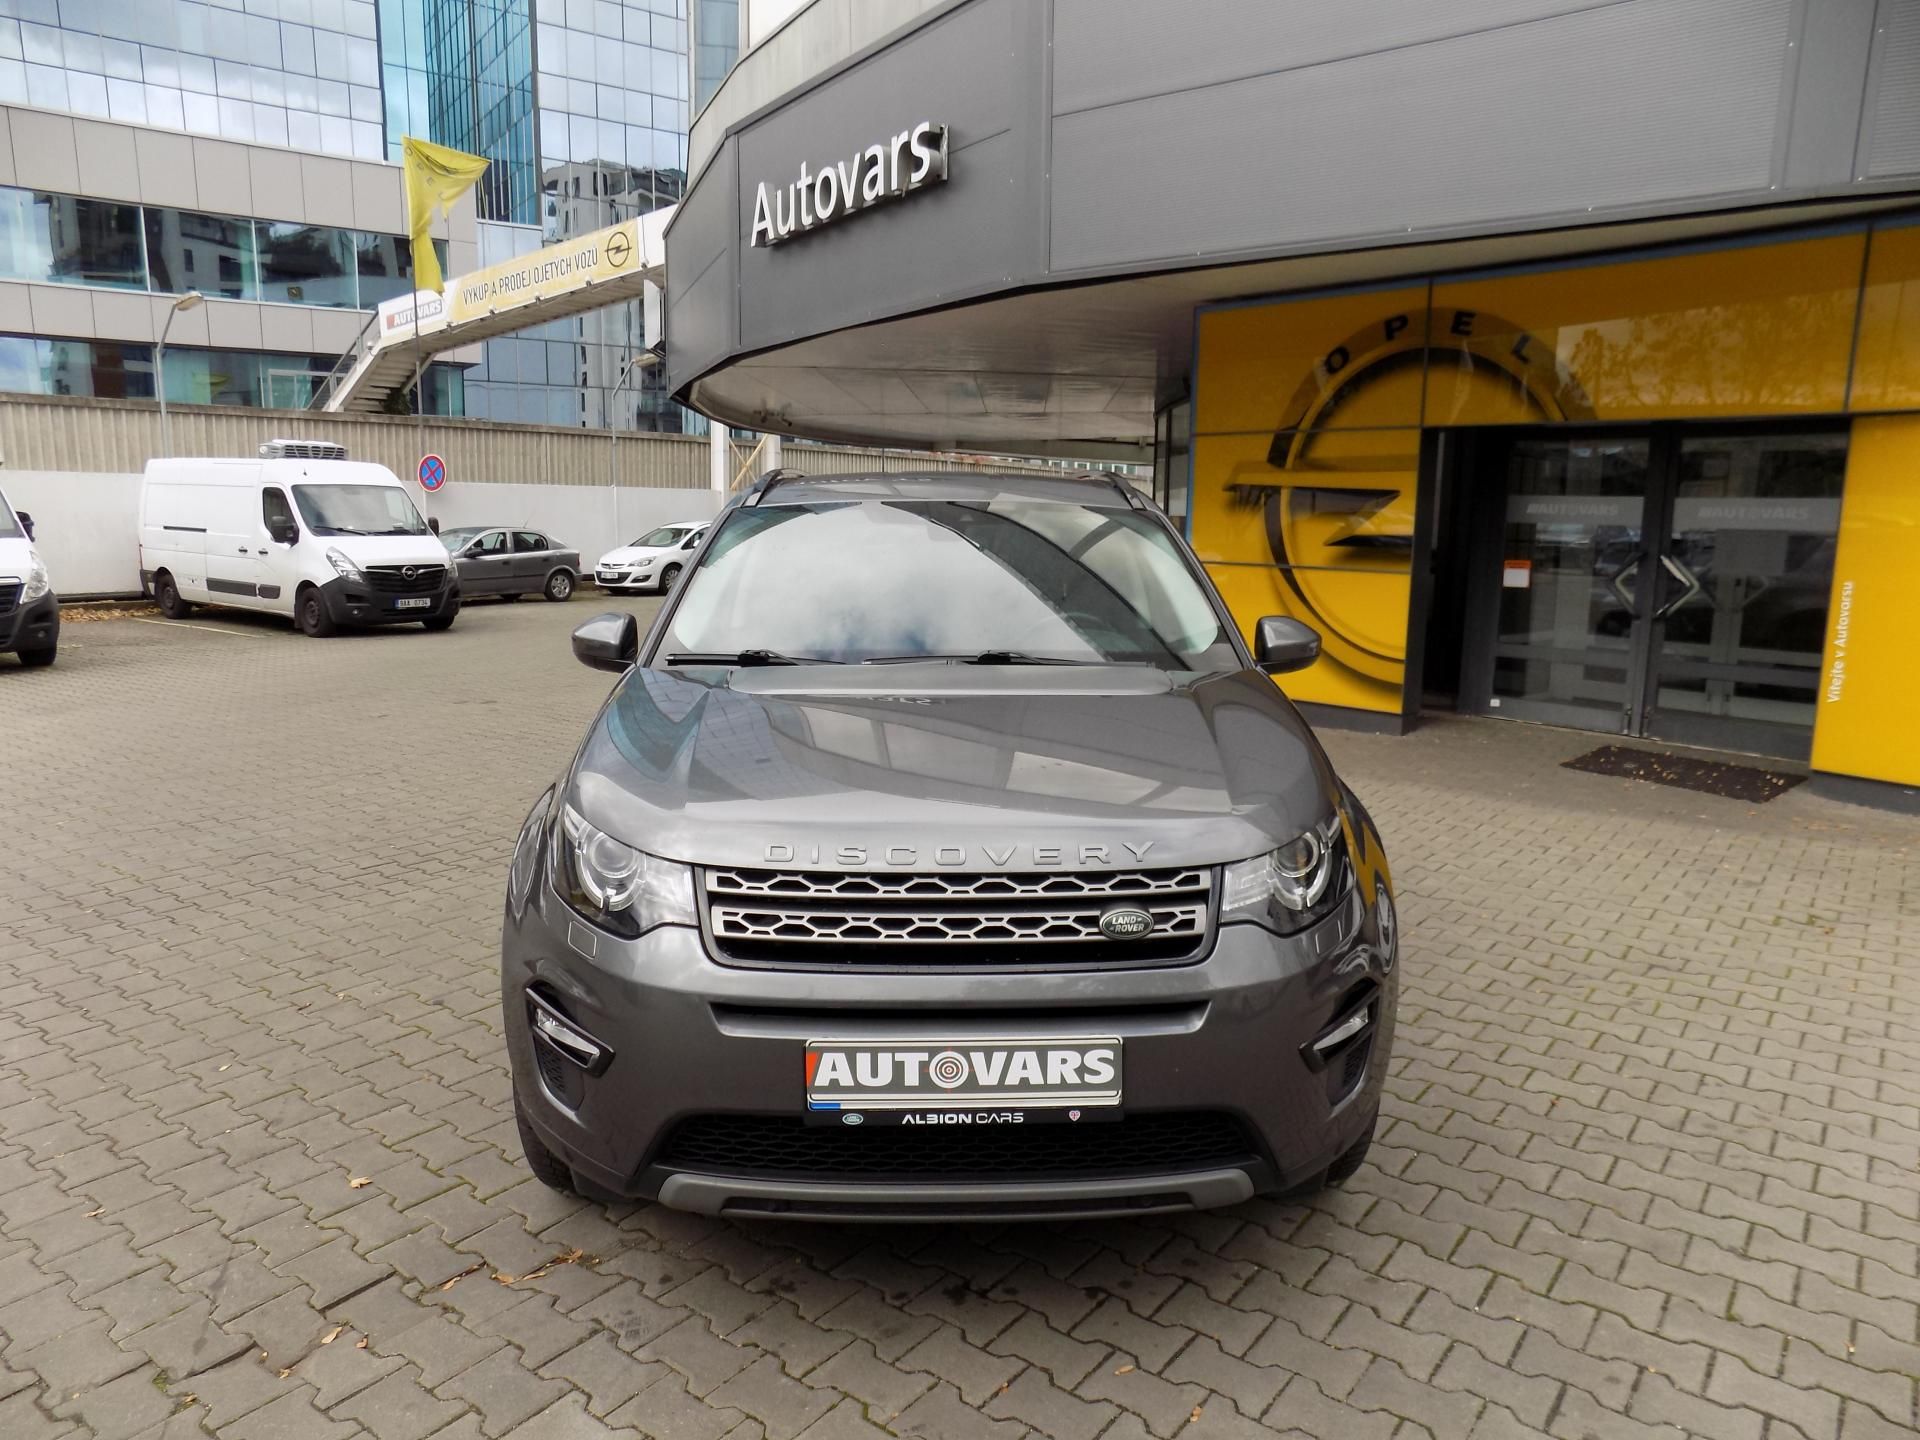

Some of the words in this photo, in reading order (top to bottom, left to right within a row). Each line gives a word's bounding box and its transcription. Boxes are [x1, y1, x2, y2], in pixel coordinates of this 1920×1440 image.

[751, 120, 936, 247] Autovars
[491, 281, 498, 297] A
[499, 269, 531, 295] PRODEJ
[1325, 310, 1532, 374] OPEL
[763, 841, 1155, 866] DISCOVERY
[1112, 916, 1137, 925] LAND
[1115, 923, 1145, 933] ROVER
[814, 1049, 1115, 1089] AUTOVARS
[901, 1113, 972, 1125] ALBION
[975, 1112, 1025, 1124] CARS
